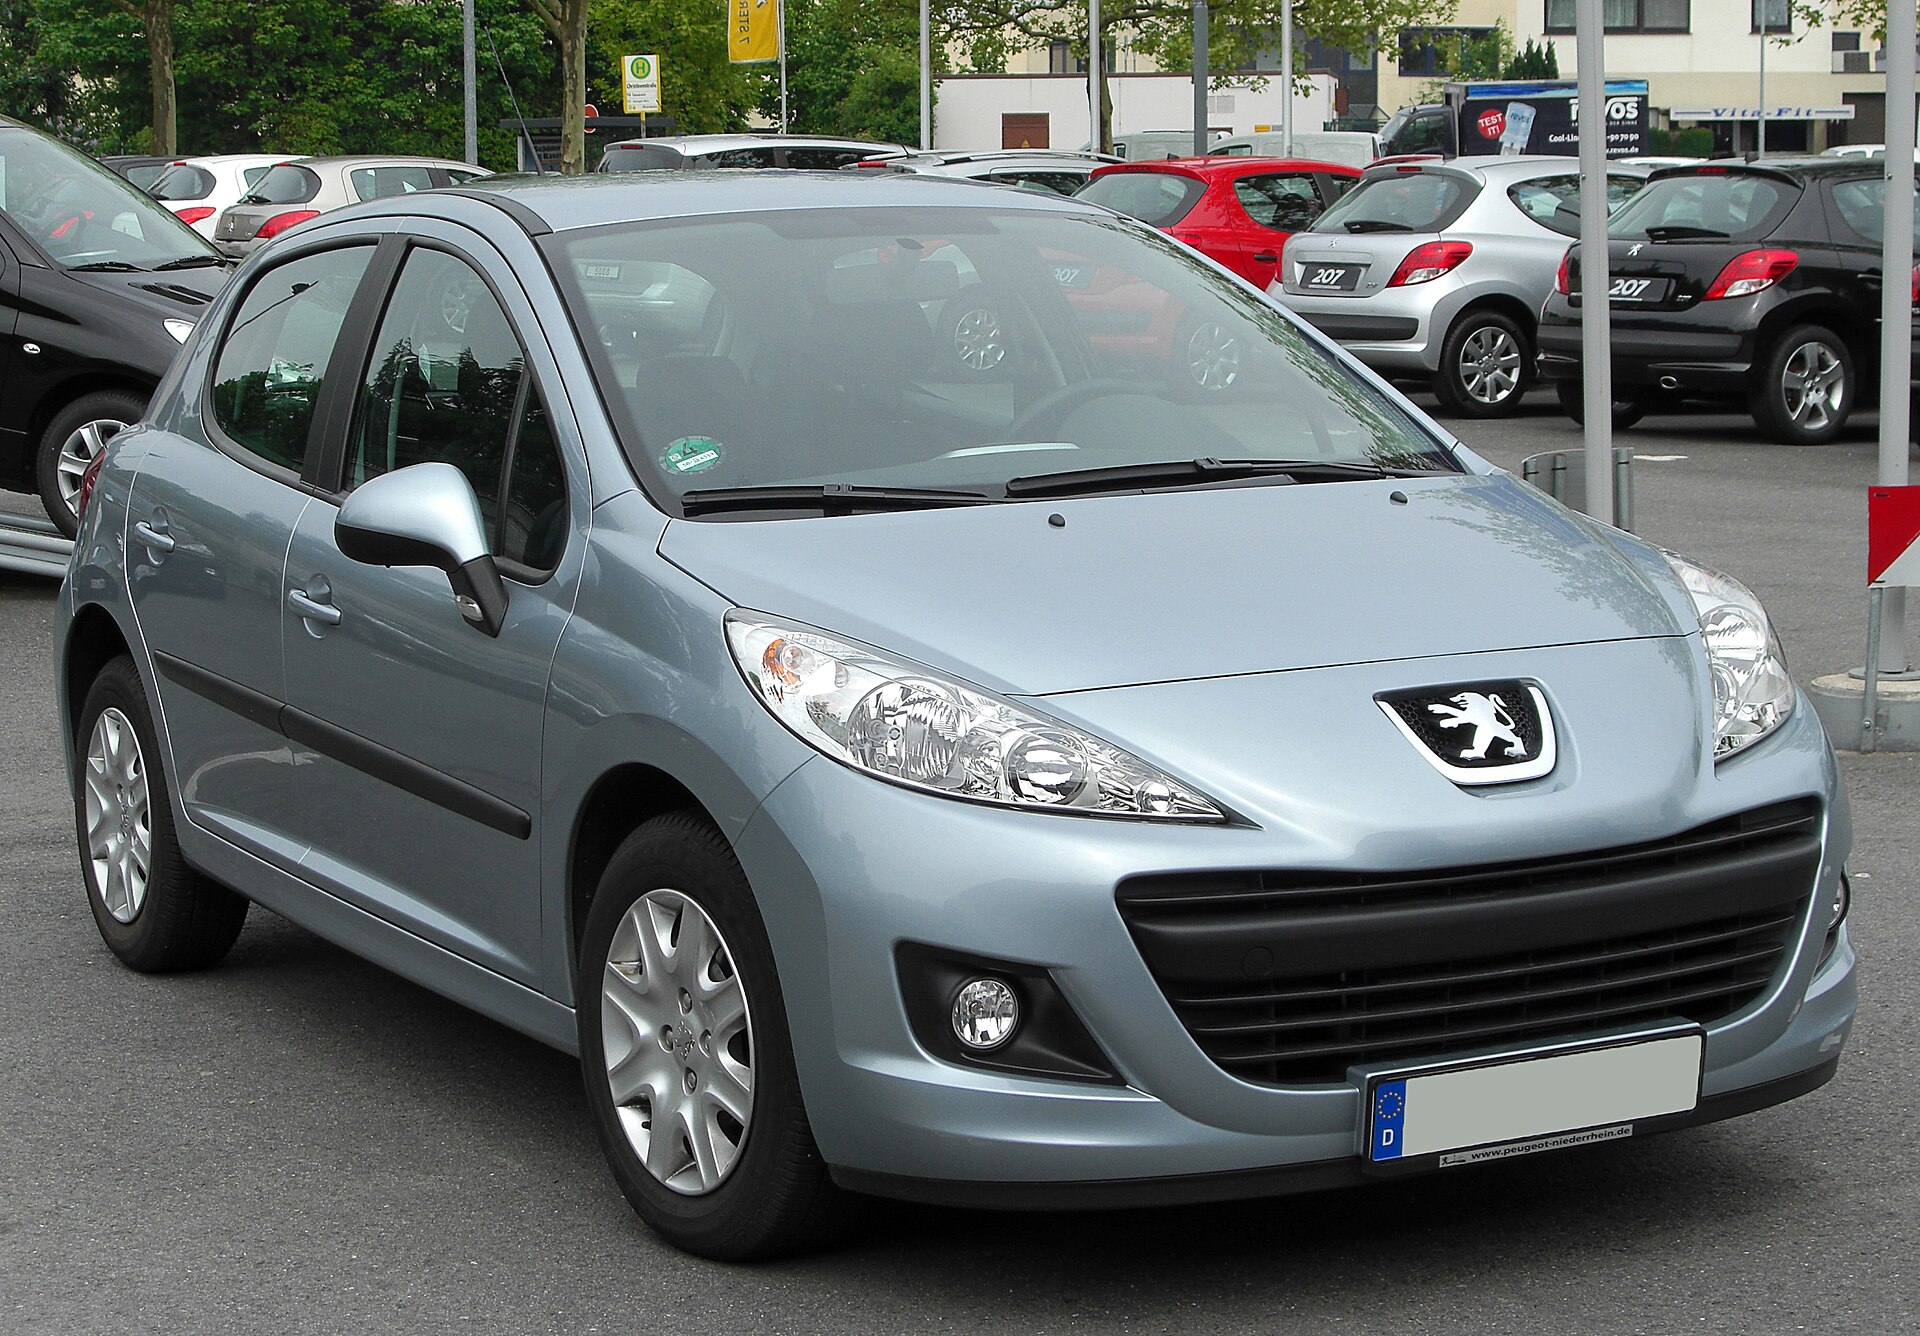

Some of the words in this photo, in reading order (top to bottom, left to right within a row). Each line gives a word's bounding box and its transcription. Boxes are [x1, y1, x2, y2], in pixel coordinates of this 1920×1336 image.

[636, 62, 646, 74] H
[1478, 113, 1503, 127] TEST
[1488, 125, 1500, 135] IT!
[1620, 134, 1629, 142] 70
[1630, 134, 1639, 142] 90
[1311, 268, 1346, 284] 207
[1608, 279, 1651, 297] 207
[683, 443, 698, 456] 4
[1381, 1128, 1394, 1147] D
[1471, 1127, 1631, 1160] www.peugeot-niederrhein.de
